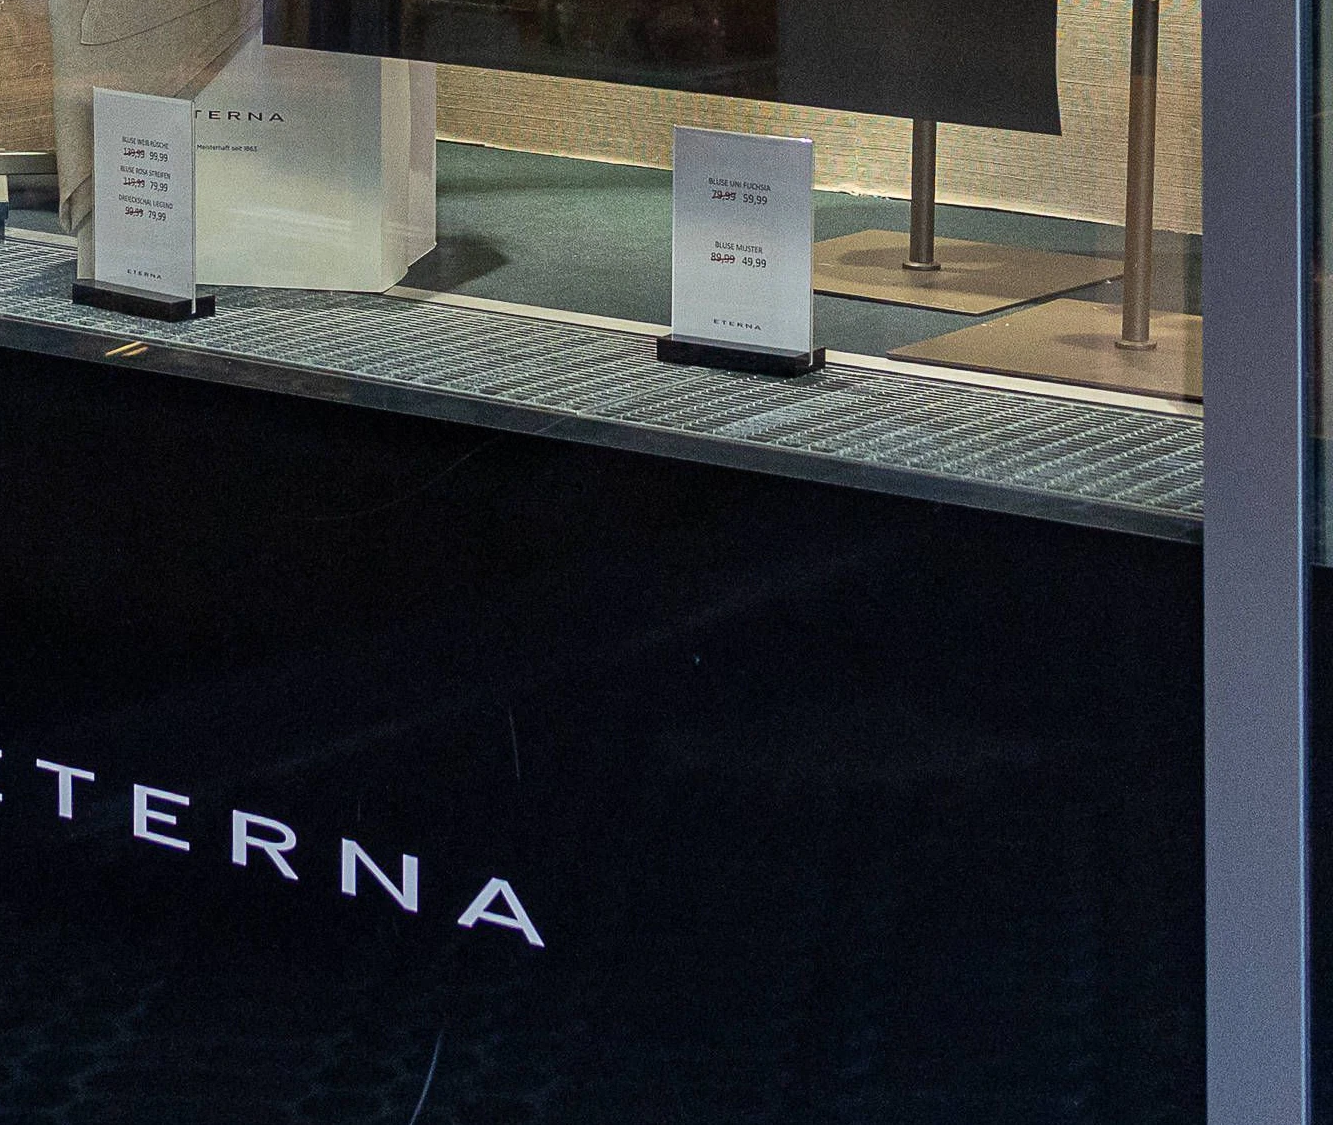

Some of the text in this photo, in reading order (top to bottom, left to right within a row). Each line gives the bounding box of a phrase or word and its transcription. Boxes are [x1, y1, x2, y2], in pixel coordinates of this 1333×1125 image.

[194, 109, 285, 122] TERNA
[149, 151, 168, 162] 99,99
[150, 181, 168, 192] 79,99
[708, 177, 729, 187] BLUSE
[743, 194, 768, 206] 59,99
[148, 210, 167, 221] 79,99
[715, 240, 763, 254] BLUSE MUSTER
[741, 257, 767, 268] 49,99
[713, 318, 762, 331] ETERNA
